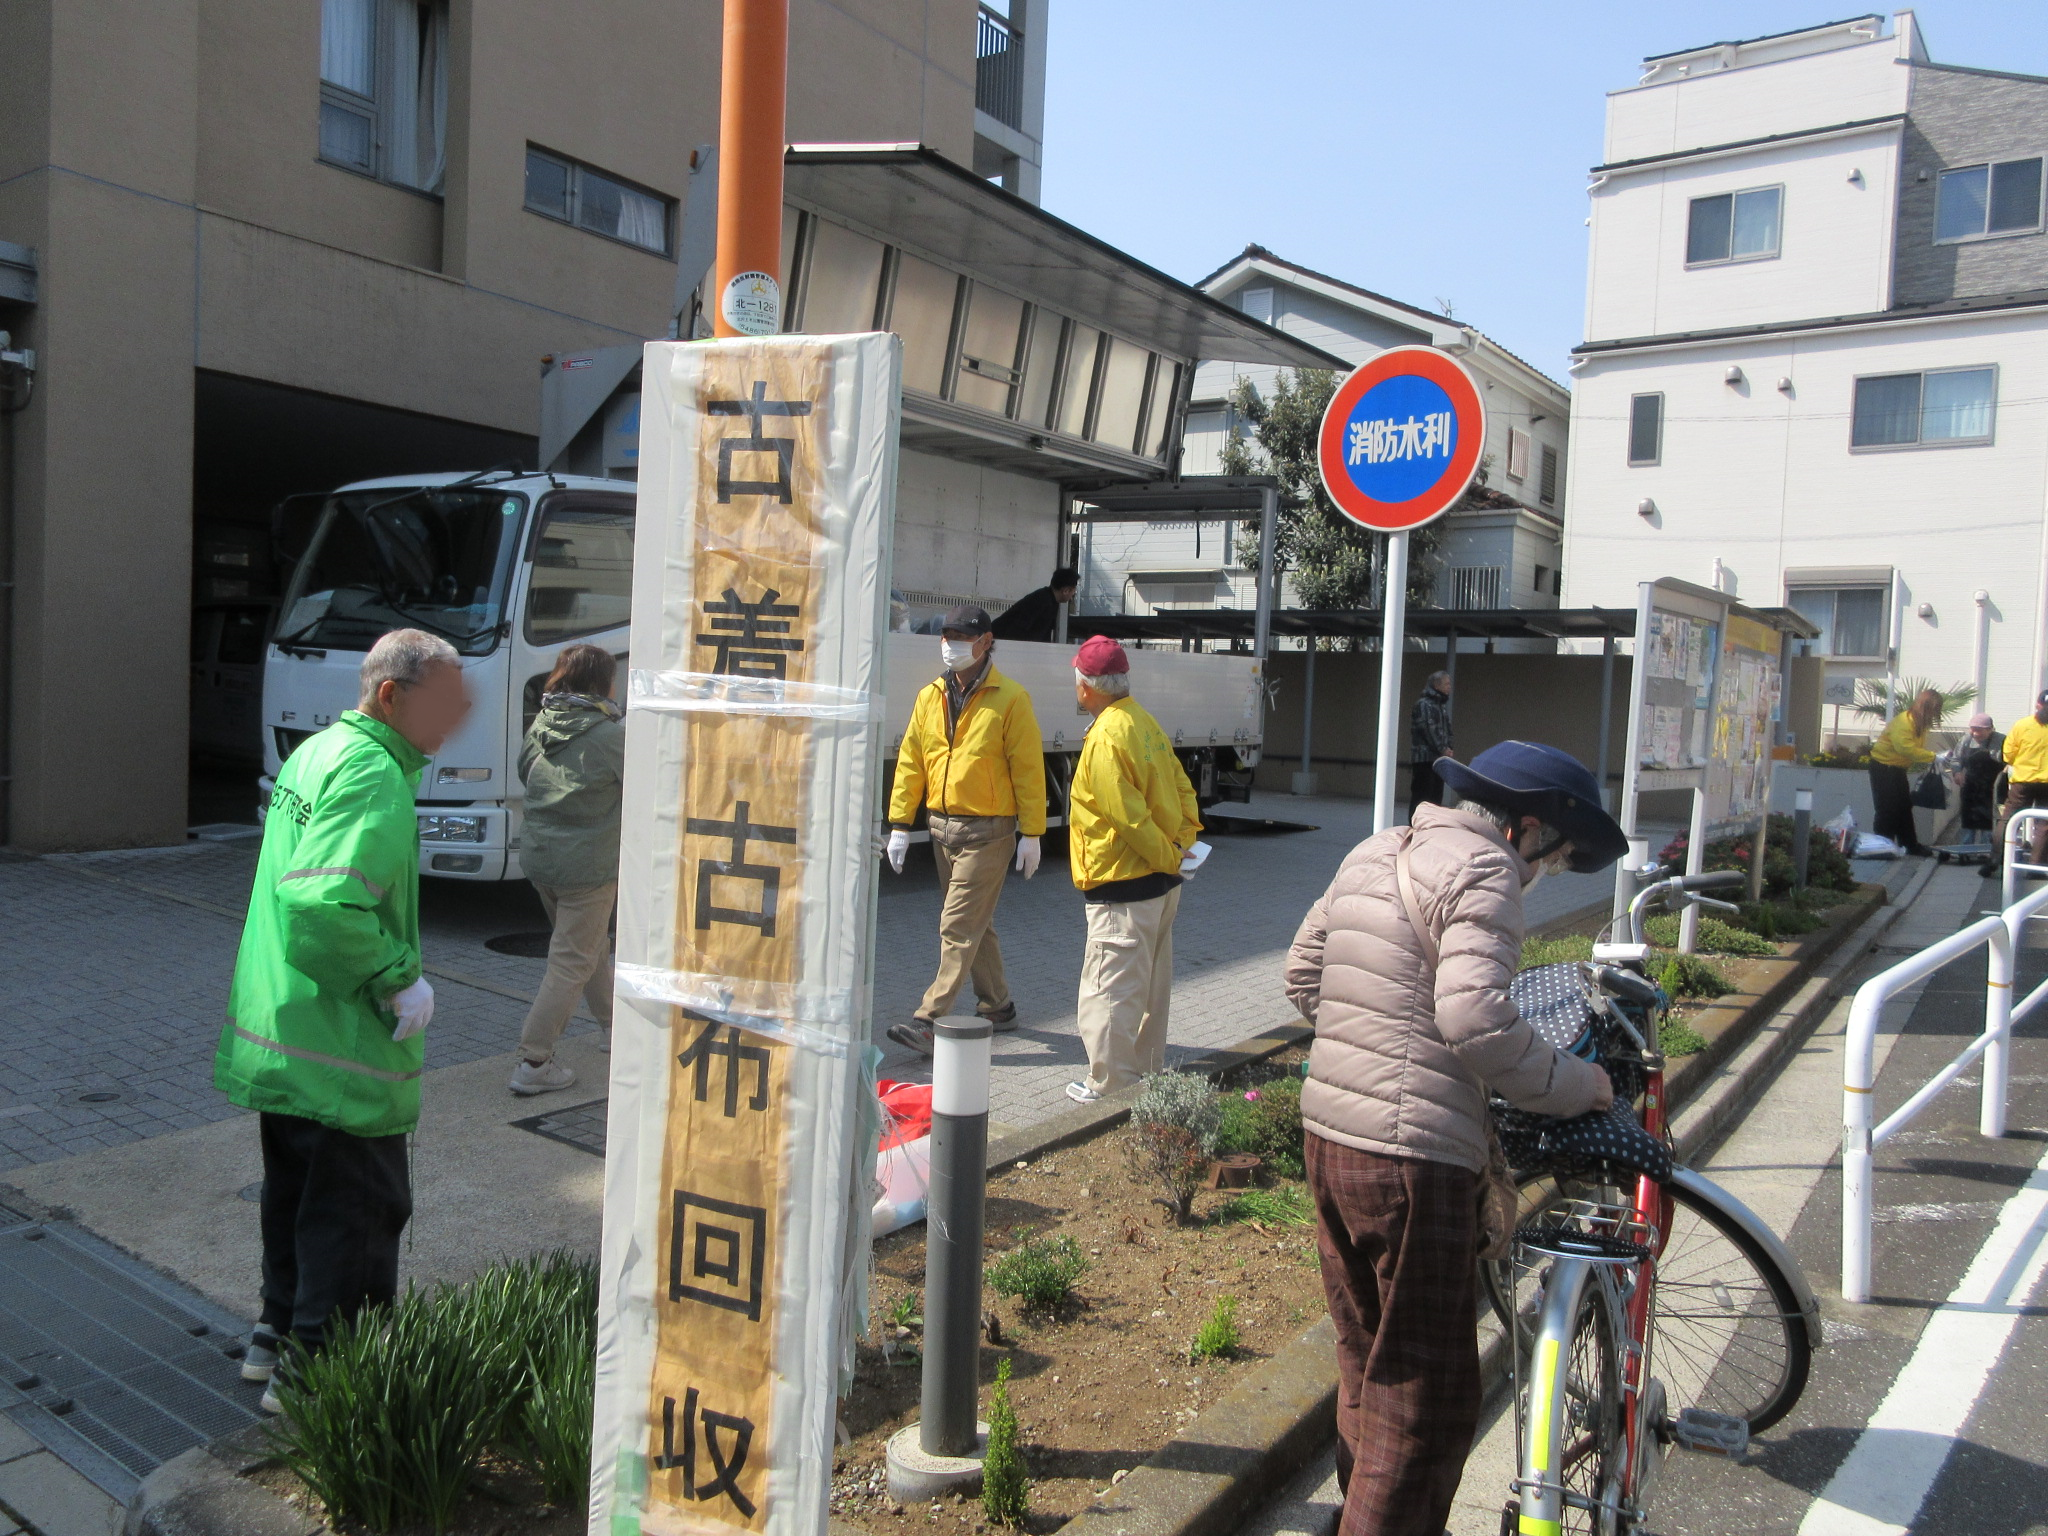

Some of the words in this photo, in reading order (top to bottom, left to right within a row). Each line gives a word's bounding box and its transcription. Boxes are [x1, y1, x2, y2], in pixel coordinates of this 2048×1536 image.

[1349, 412, 1450, 465] 消防水利
[653, 381, 812, 1519] 古着古布回収
